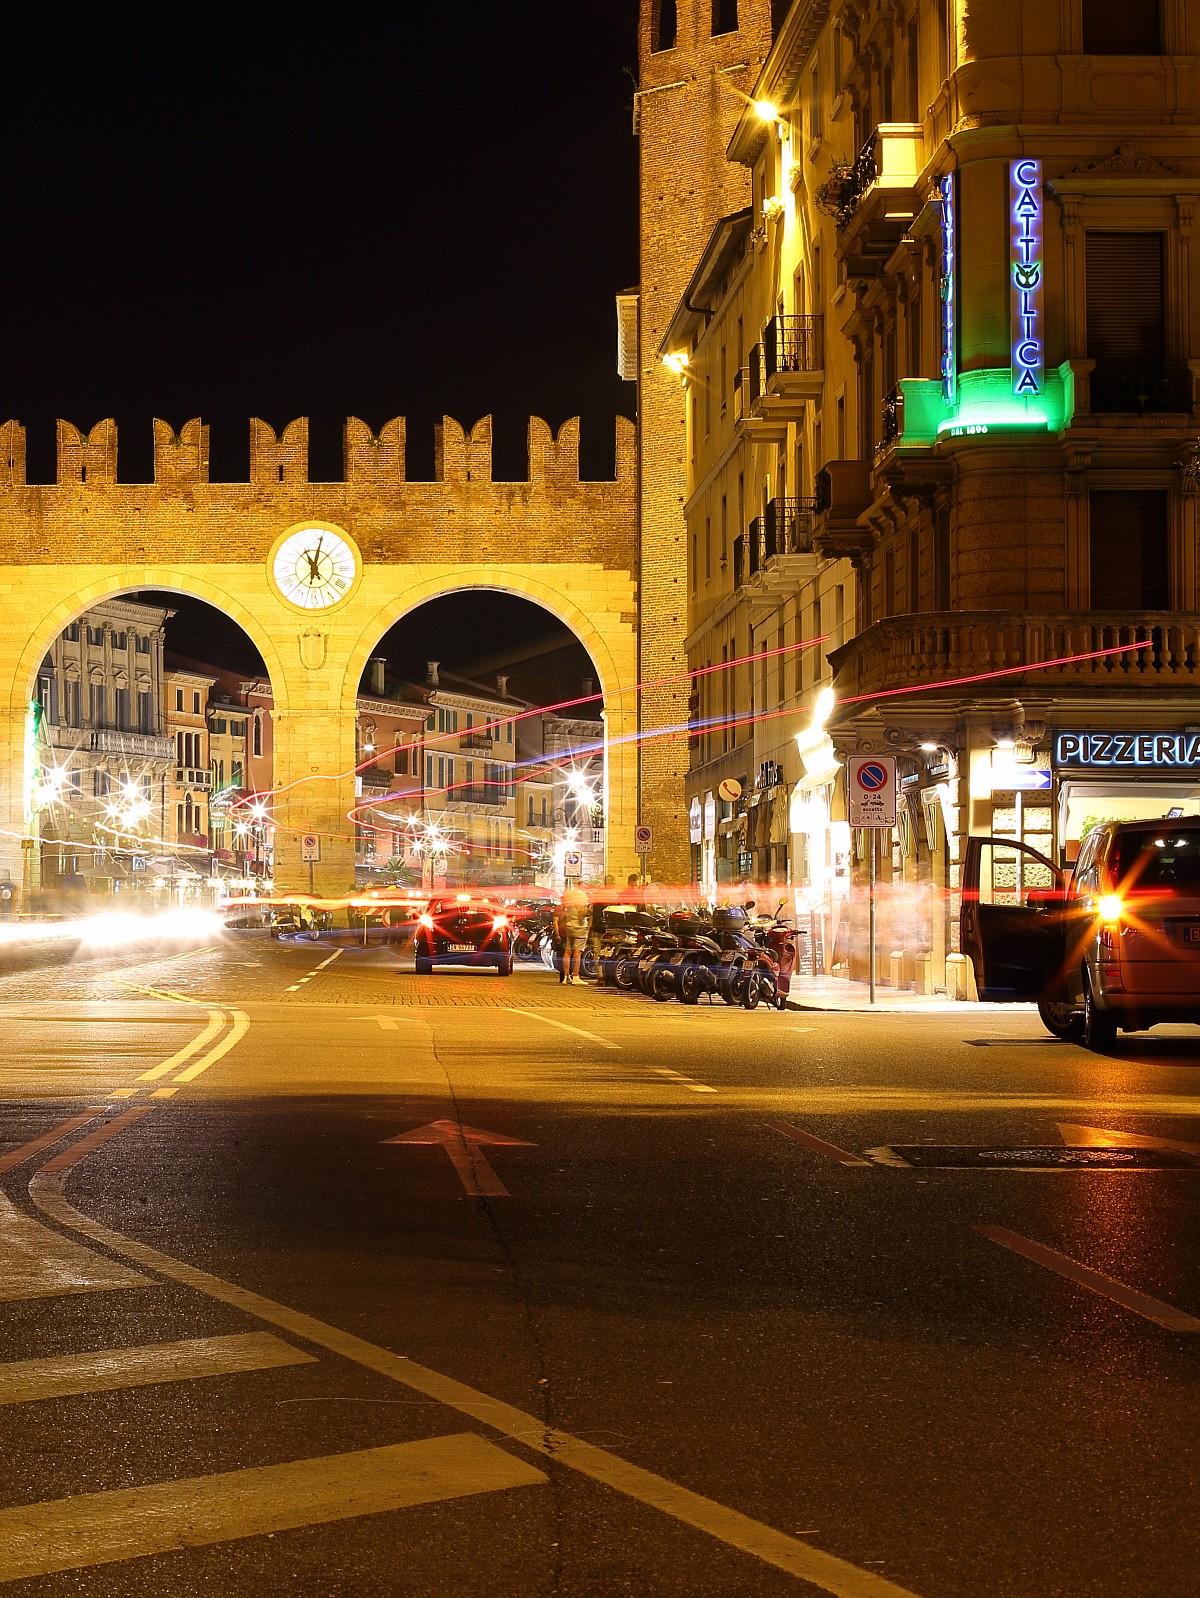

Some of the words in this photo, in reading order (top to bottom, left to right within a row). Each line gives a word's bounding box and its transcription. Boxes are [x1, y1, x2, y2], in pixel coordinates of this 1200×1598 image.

[1013, 160, 1040, 394] CATTOLICA
[951, 427, 964, 436] DAL
[966, 425, 988, 434] 1896
